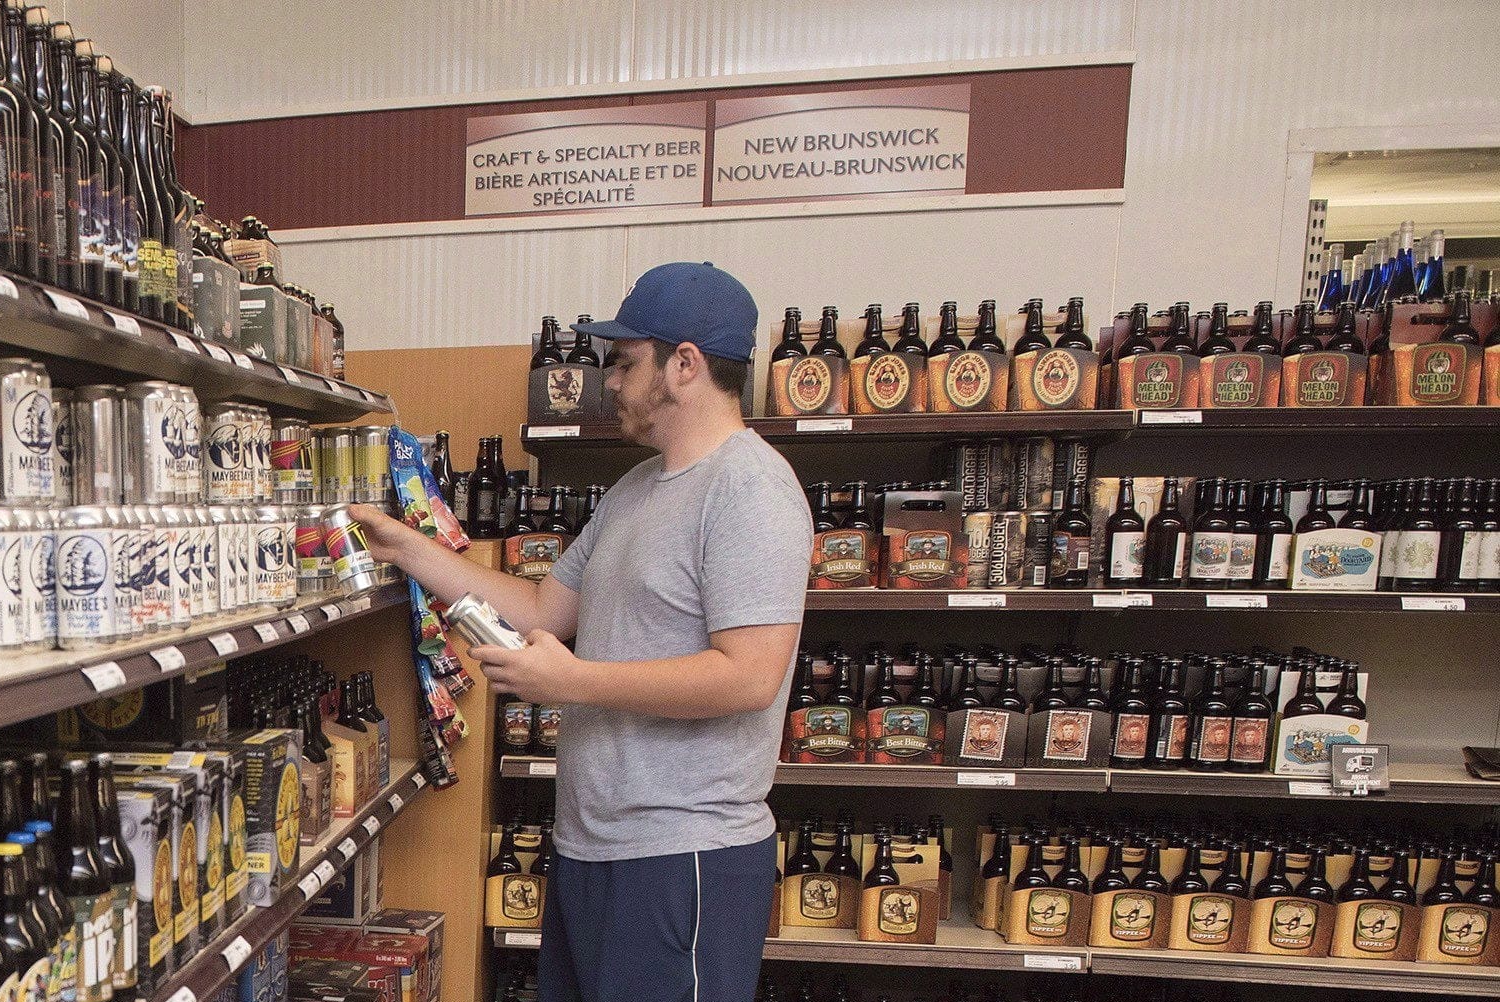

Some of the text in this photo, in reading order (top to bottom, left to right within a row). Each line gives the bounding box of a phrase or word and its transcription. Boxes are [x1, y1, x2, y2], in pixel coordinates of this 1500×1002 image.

[743, 127, 940, 155] NEW BRUNSWICK
[472, 140, 701, 169] CRAFT & SPECIALTY BEER
[716, 152, 966, 182] NOUVEAU-BRUNSWICK
[475, 163, 699, 190] BIÈRE ARTISANALE ET DE
[532, 184, 636, 207] SPÉCIALITÉ
[1417, 373, 1455, 384] MELON
[1137, 383, 1173, 392] MELON
[1217, 383, 1253, 392] MELON
[1302, 381, 1339, 391] MELON
[1420, 383, 1451, 394] HEAD
[1141, 391, 1169, 401] HEAD
[1220, 391, 1249, 401] HEAD
[1305, 390, 1334, 401] HEAD
[826, 562, 861, 572] Irish Red
[908, 562, 945, 572] Irish Red
[809, 737, 850, 748] Best Bitter
[886, 738, 928, 749] Best Bitter
